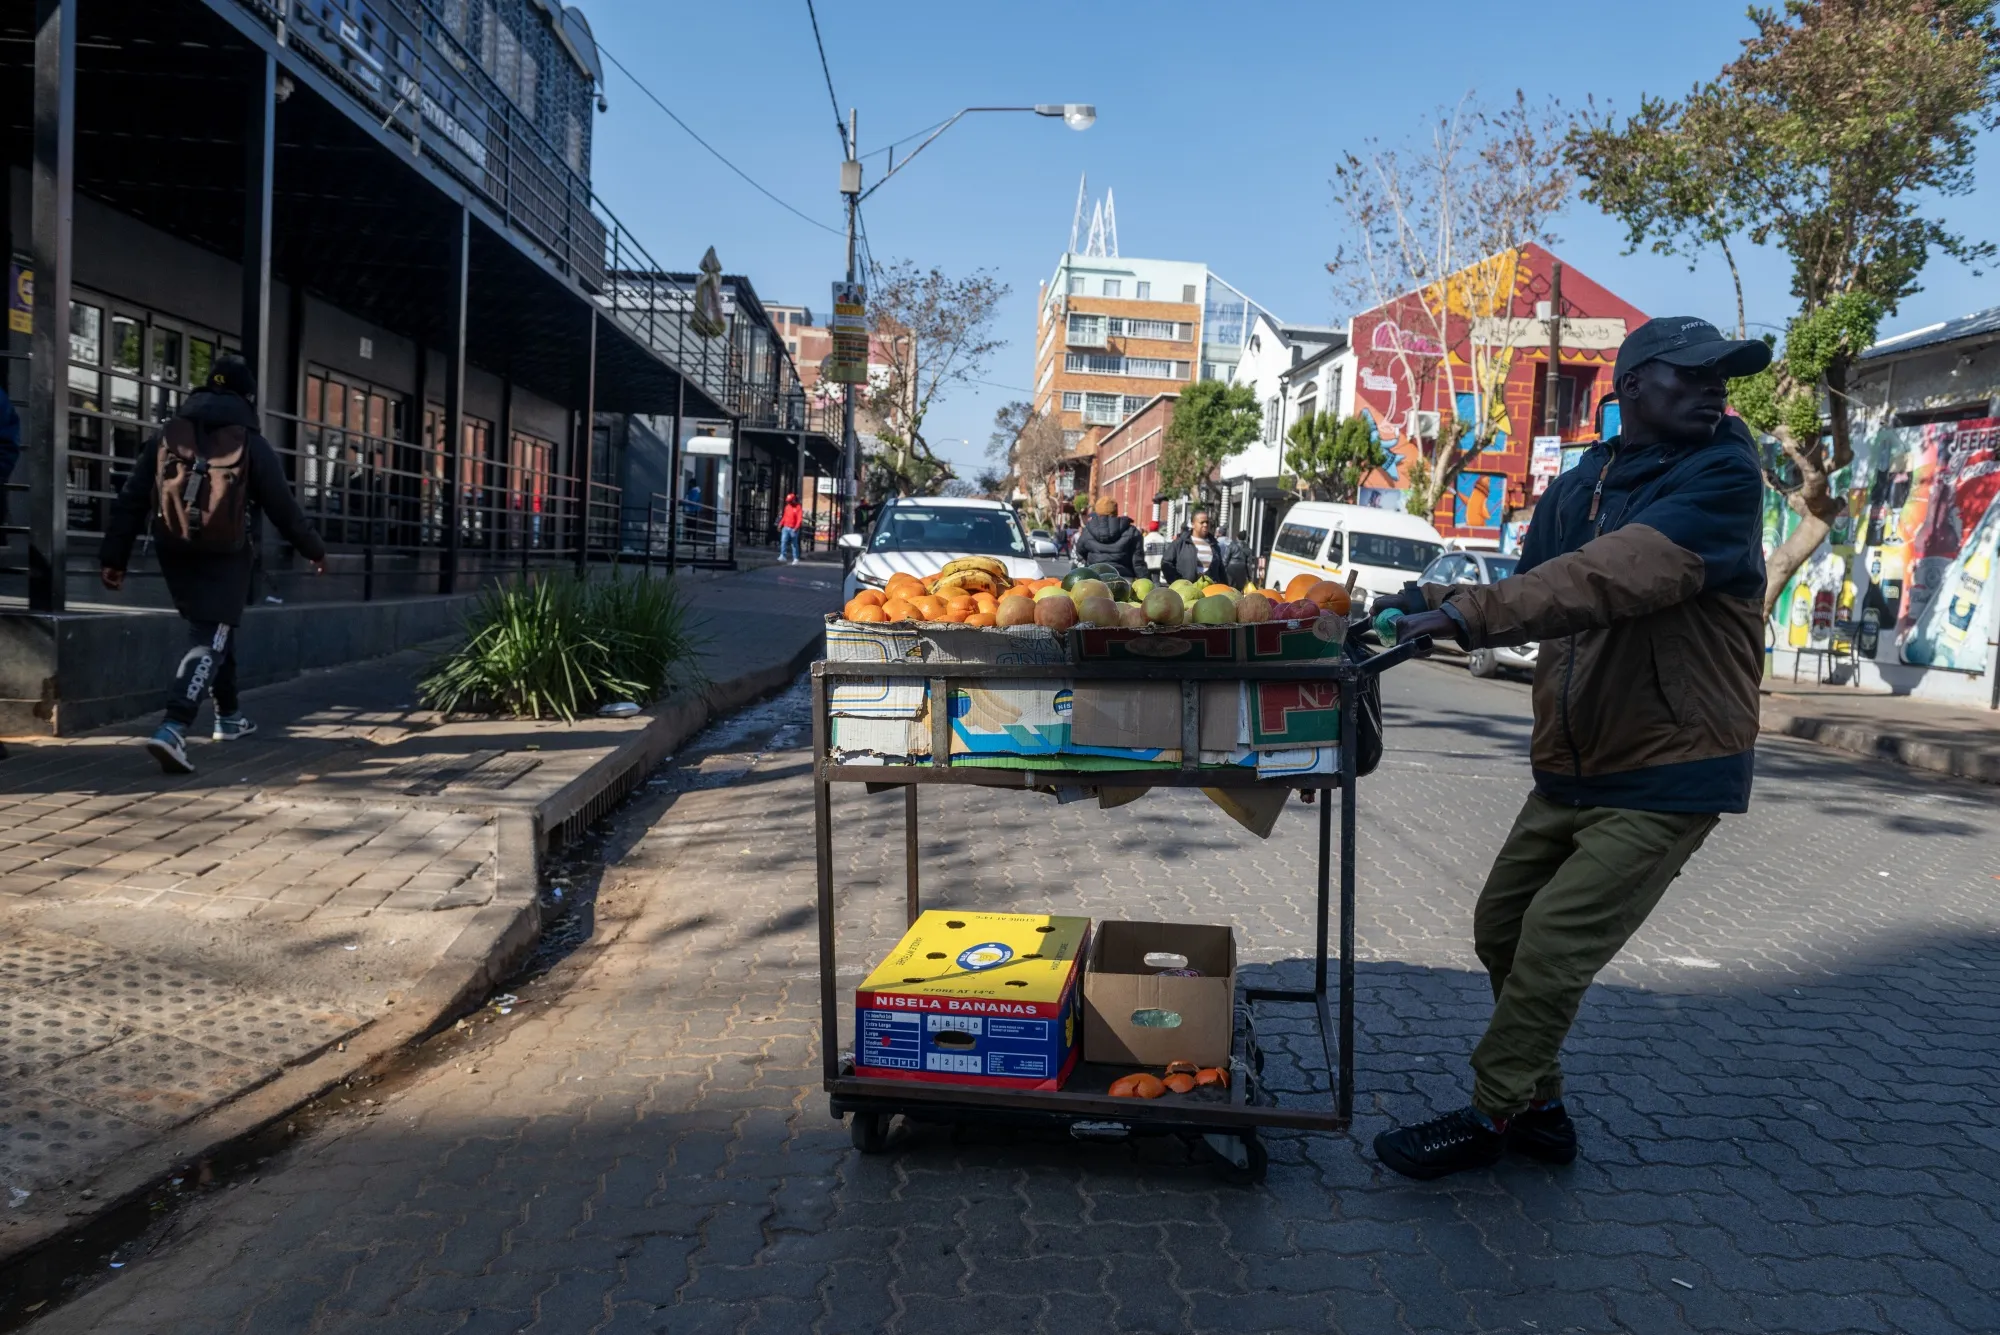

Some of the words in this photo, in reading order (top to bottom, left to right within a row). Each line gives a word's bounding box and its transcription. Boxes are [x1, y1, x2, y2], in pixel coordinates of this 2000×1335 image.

[186, 654, 213, 702] adidas
[875, 996, 942, 1009] NISELA
[948, 1000, 1037, 1015] BANANAS
